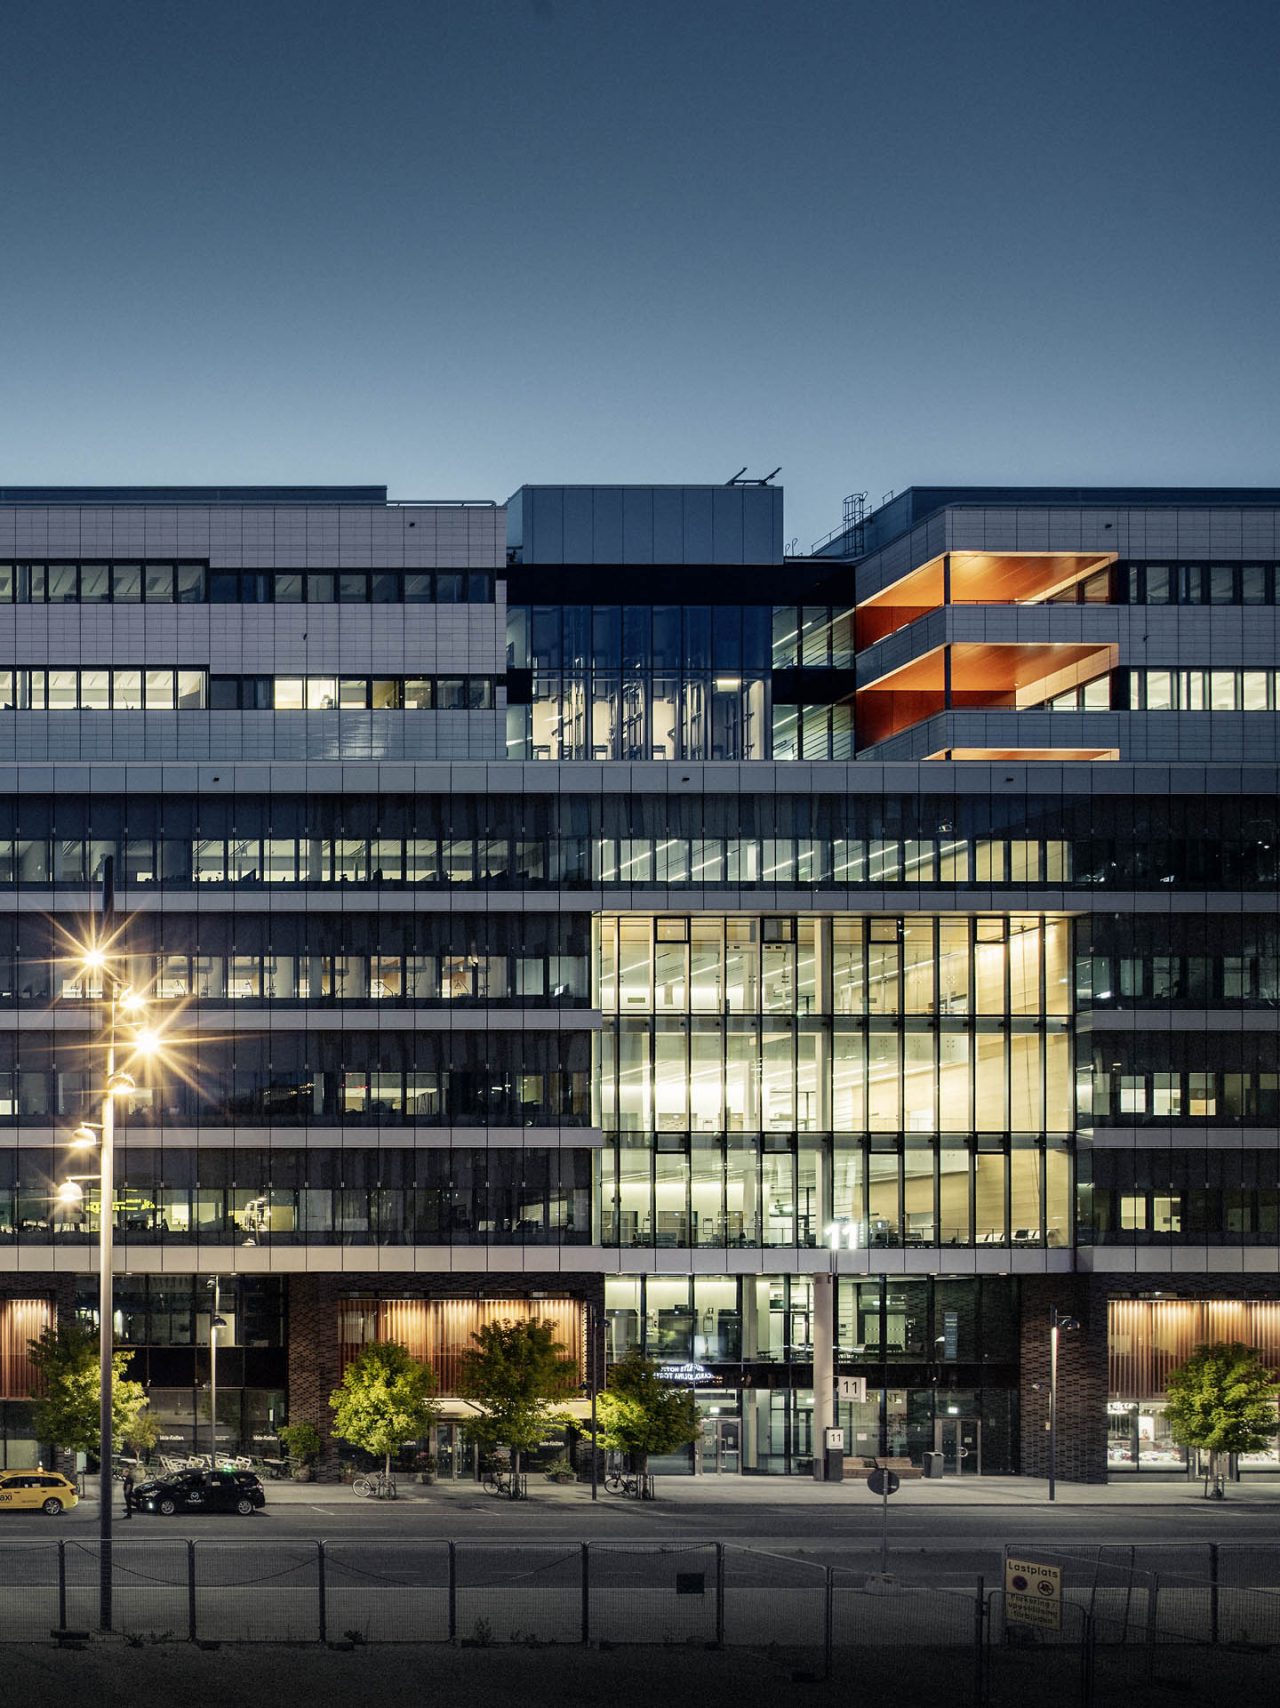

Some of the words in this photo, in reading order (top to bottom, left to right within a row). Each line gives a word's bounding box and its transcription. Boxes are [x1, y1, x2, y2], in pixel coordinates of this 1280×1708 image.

[824, 1223, 858, 1250] 11
[843, 1380, 858, 1395] 11
[831, 1433, 841, 1443] 11
[1009, 1562, 1058, 1578] Lastplats
